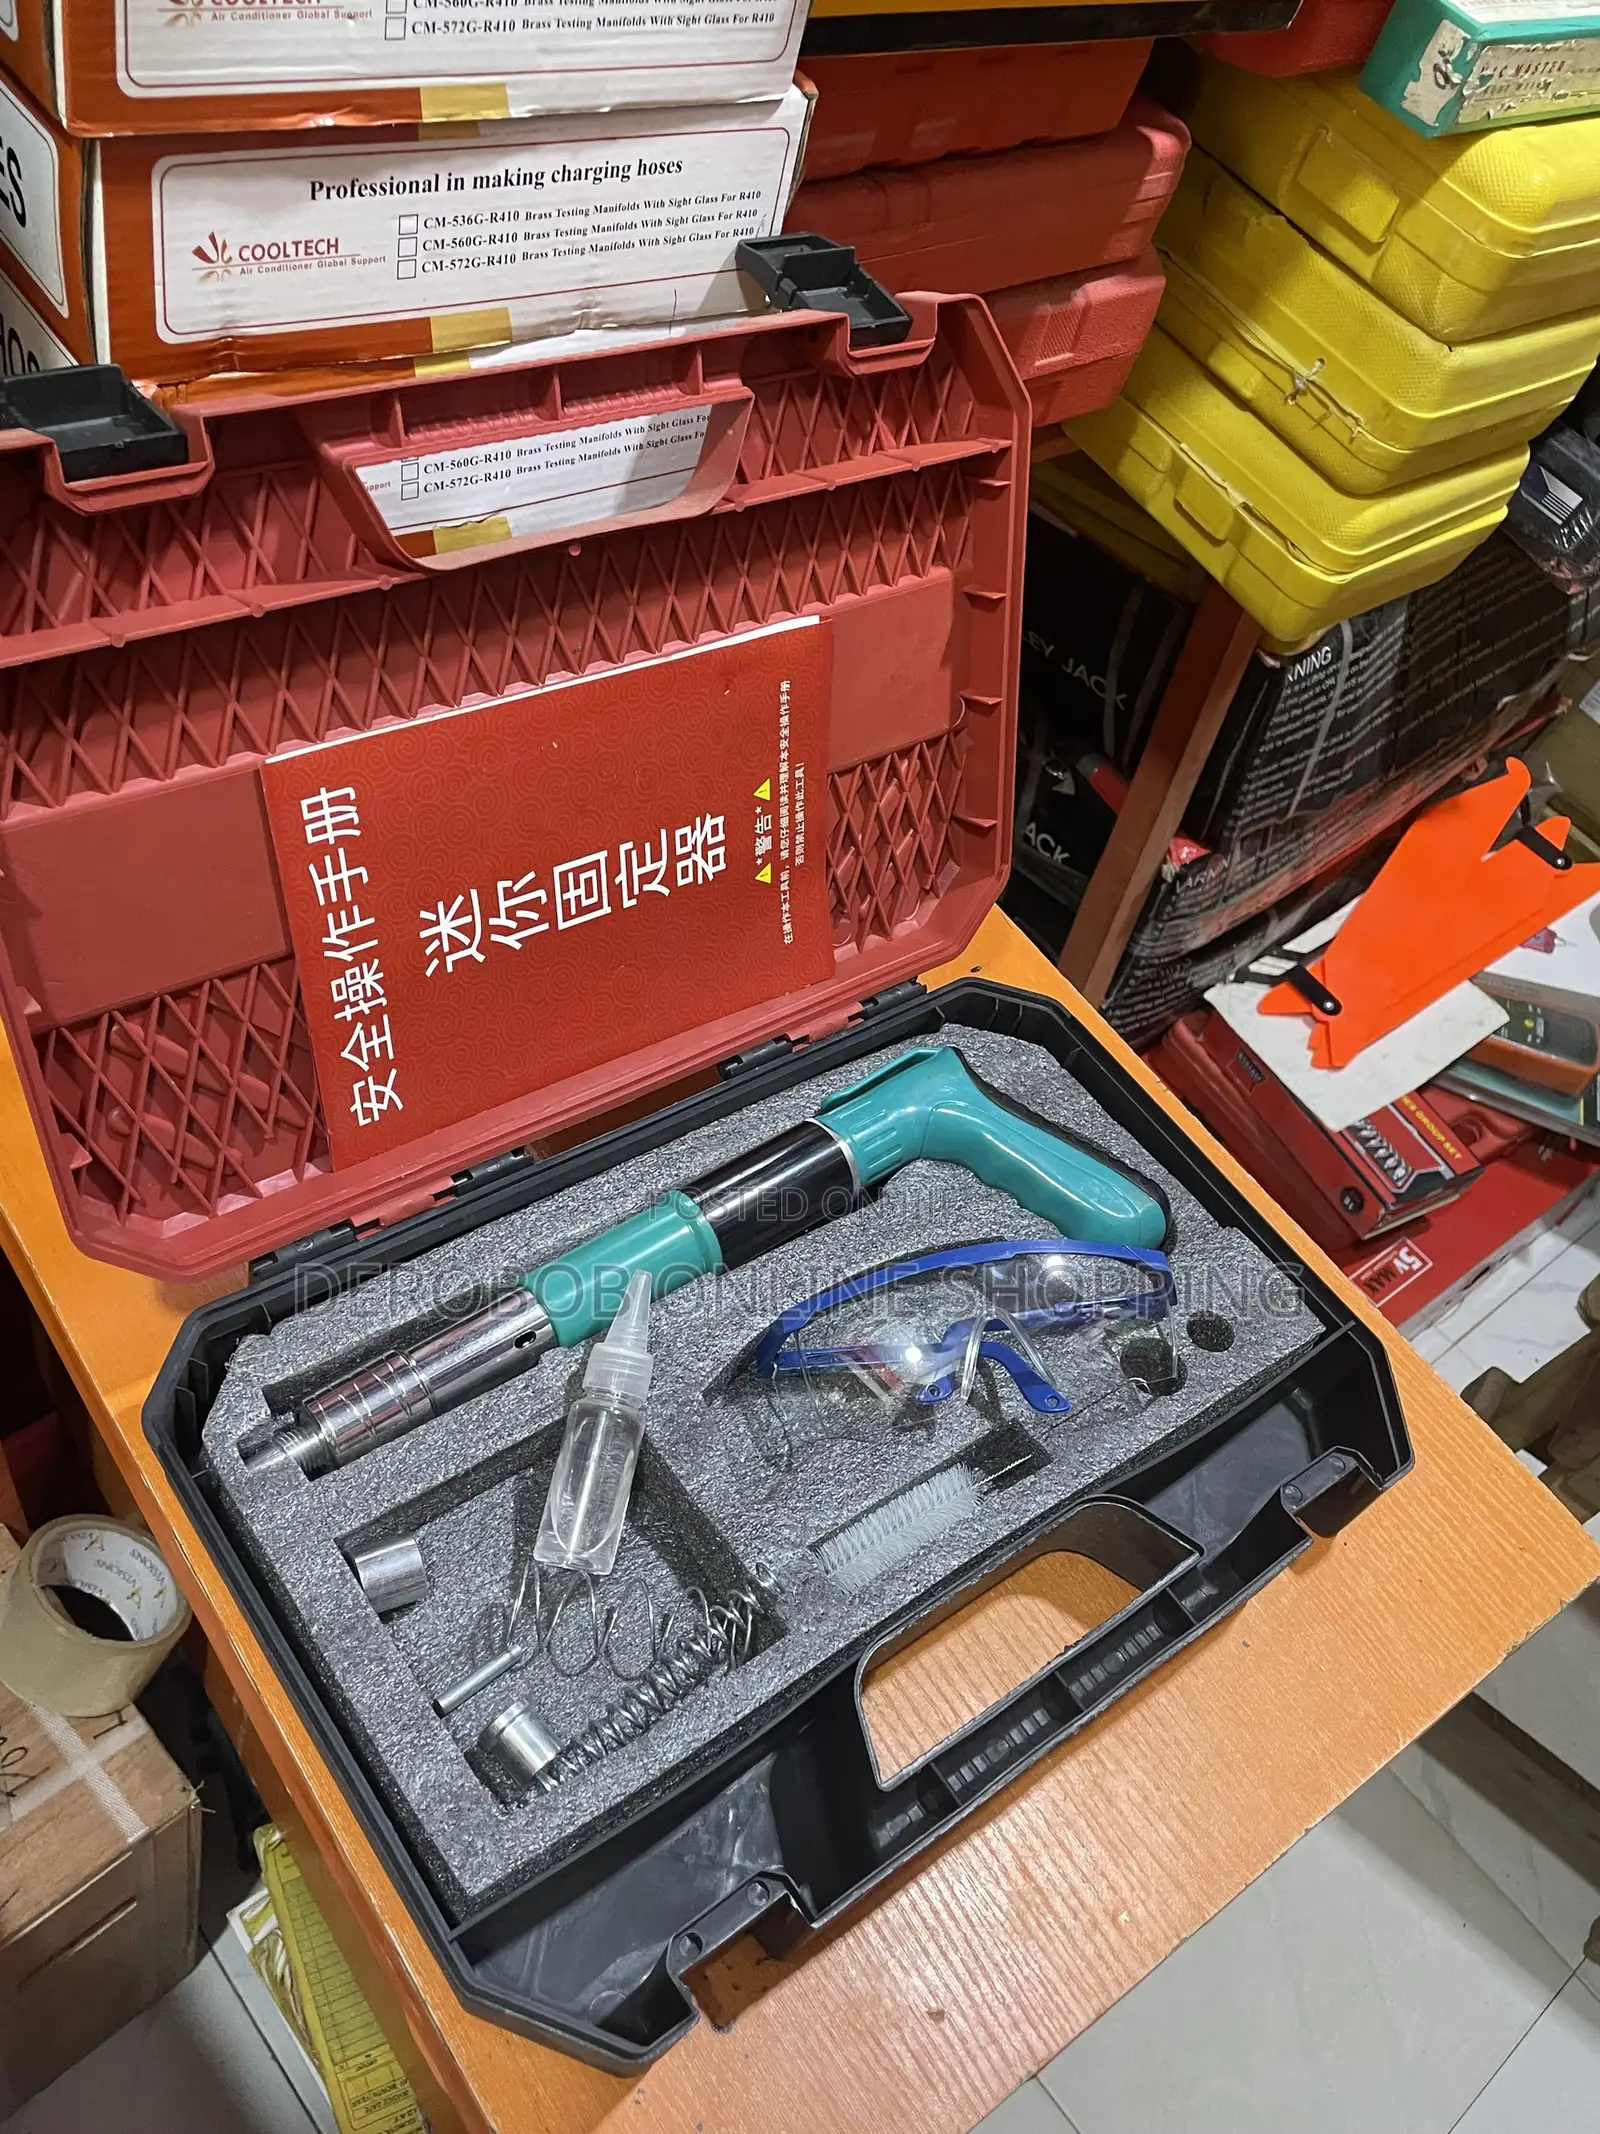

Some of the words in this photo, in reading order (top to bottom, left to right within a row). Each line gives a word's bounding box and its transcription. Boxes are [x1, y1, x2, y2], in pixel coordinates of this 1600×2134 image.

[211, 12, 225, 21] Air
[231, 12, 291, 21] Conditioner
[297, 10, 330, 20] Global
[412, 20, 516, 35] CM-572G-R410
[522, 18, 551, 29] Brass
[555, 17, 592, 30] Testing
[596, 16, 646, 28] Manifolds
[650, 15, 673, 26] With
[676, 14, 700, 27] Sight
[704, 13, 730, 24] Glass
[732, 13, 749, 23] For
[752, 12, 775, 23] R410
[310, 173, 440, 201] Professional
[446, 172, 465, 192] in
[472, 167, 546, 190] making
[551, 160, 632, 185] charging
[637, 158, 683, 177] hoses
[422, 231, 518, 252] CM-560G-R410
[523, 230, 551, 242] Brass
[554, 226, 589, 238] Testing
[591, 219, 638, 234] Manifolds
[641, 218, 663, 229] With
[665, 214, 690, 227] Sight
[691, 212, 716, 224] Glass
[717, 210, 734, 221] For
[735, 208, 759, 219] R410
[423, 210, 520, 230] CM-536G-R410
[525, 209, 552, 222] Brass
[555, 206, 591, 218] Testing
[593, 200, 640, 215] Manifolds
[643, 199, 666, 209] With
[668, 196, 692, 209] Sight
[694, 194, 719, 205] Glass
[721, 192, 737, 202] For
[739, 190, 762, 200] R410
[238, 236, 339, 262] COOLTECH
[239, 266, 253, 276] Air
[257, 262, 313, 274] Conditioner
[317, 258, 347, 269] Global
[351, 255, 387, 267] Support
[421, 252, 517, 273] CM-572G-R410
[522, 250, 549, 262] Brass
[552, 245, 586, 257] Testing
[588, 239, 636, 253] Manifolds
[638, 237, 661, 248] With
[662, 233, 687, 246] Sight
[688, 231, 713, 242] Glass
[714, 229, 730, 239] For
[732, 226, 755, 237] R410
[424, 450, 512, 475] CM-560G-R410
[516, 446, 542, 458] Brass
[544, 438, 577, 451] Testing
[579, 430, 622, 446] Manifolds
[624, 425, 645, 436] With
[647, 420, 670, 433] Sight
[671, 417, 694, 428] Glass
[424, 469, 512, 493] CM-572G-R410
[516, 464, 542, 475] Brass
[544, 456, 576, 469] Testing
[578, 447, 621, 463] Manifolds
[623, 443, 644, 453] With
[646, 438, 668, 450] Sight
[670, 434, 692, 444] Glass
[366, 481, 391, 492] pport
[419, 812, 727, 978] 迷你固定器
[299, 786, 404, 1127] 安全操作手册
